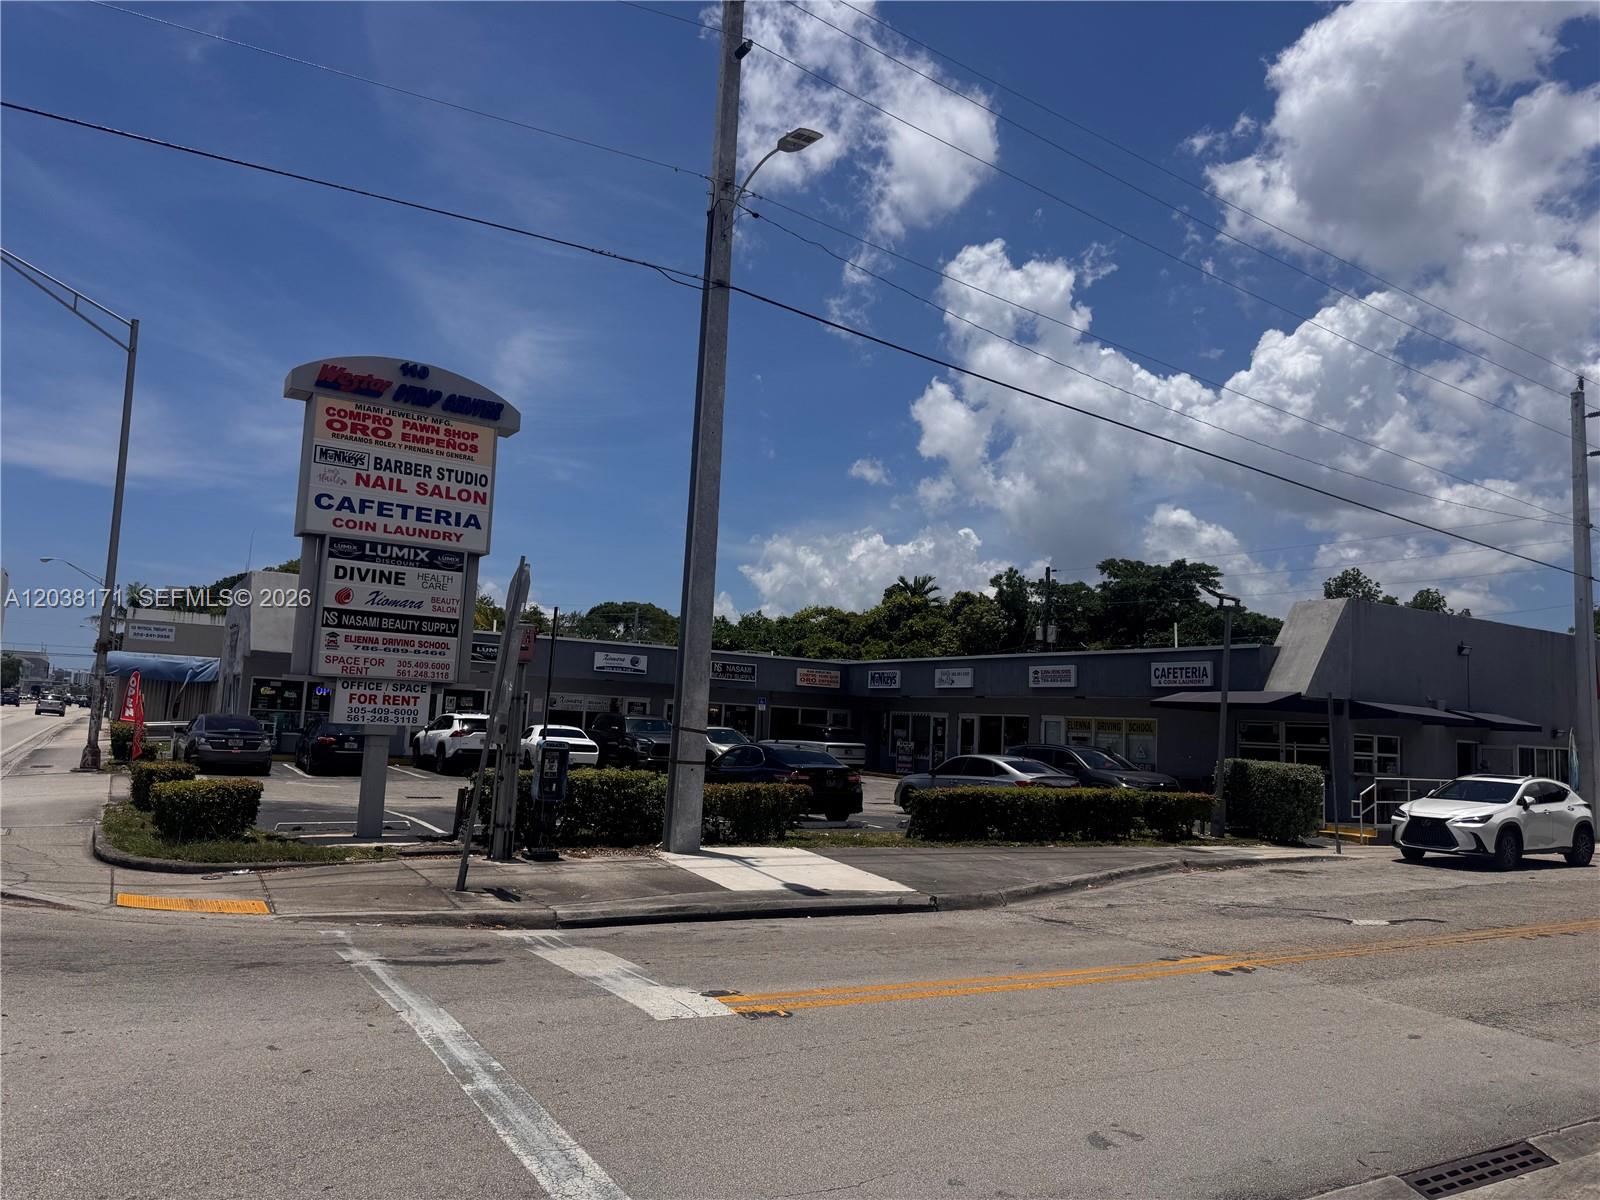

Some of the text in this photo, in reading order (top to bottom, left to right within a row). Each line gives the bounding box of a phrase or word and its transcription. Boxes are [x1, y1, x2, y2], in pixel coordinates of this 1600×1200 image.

[355, 404, 454, 428] MIAMI JEWELRY MFG.
[325, 406, 479, 442] COMPRO PAWN SHOP
[325, 419, 479, 454] ORO EMPEÑOS
[331, 432, 373, 445] REPARAMOS
[374, 439, 396, 449] ROLEX
[404, 443, 434, 455] PRENDAS
[435, 449, 445, 457] EN
[446, 450, 476, 462] GENERAL
[374, 456, 489, 488] BARBER STUDIO
[355, 472, 488, 505] NAIL SALON
[314, 493, 482, 530] CAFETERIA
[332, 517, 464, 543] COIN LAUNDRY
[365, 543, 430, 562] LUMIX
[375, 558, 420, 568] DISCOUNT
[334, 565, 407, 587] DIVINE
[417, 572, 453, 585] HEALTH
[421, 581, 448, 591] CARE
[364, 590, 425, 610] Xiomara
[431, 596, 460, 606] BEAUTY
[431, 605, 457, 614] SALON
[342, 614, 380, 629] NASAMI
[381, 619, 420, 632] BEAUTY
[421, 623, 457, 635] SUPPLY
[344, 634, 451, 650] ELIENNA DRIVING SCHOOL
[476, 646, 498, 654] LUM
[324, 655, 385, 668] SPACE FOR
[397, 660, 451, 671] 305.409.6000
[341, 666, 370, 676] RENT
[396, 669, 449, 680] 561.248.3118
[726, 664, 753, 674] NASAMI
[1153, 666, 1209, 679] CAFETERIA
[341, 680, 383, 692] OFFICE
[391, 683, 427, 694] SPACE
[125, 677, 137, 717] OPEN
[348, 693, 420, 706] FOR RENT
[347, 706, 419, 717] 305-409-6000
[346, 715, 418, 725] 561-248-3118
[1067, 720, 1153, 733] ELIENNA DRIVING SCHOOL
